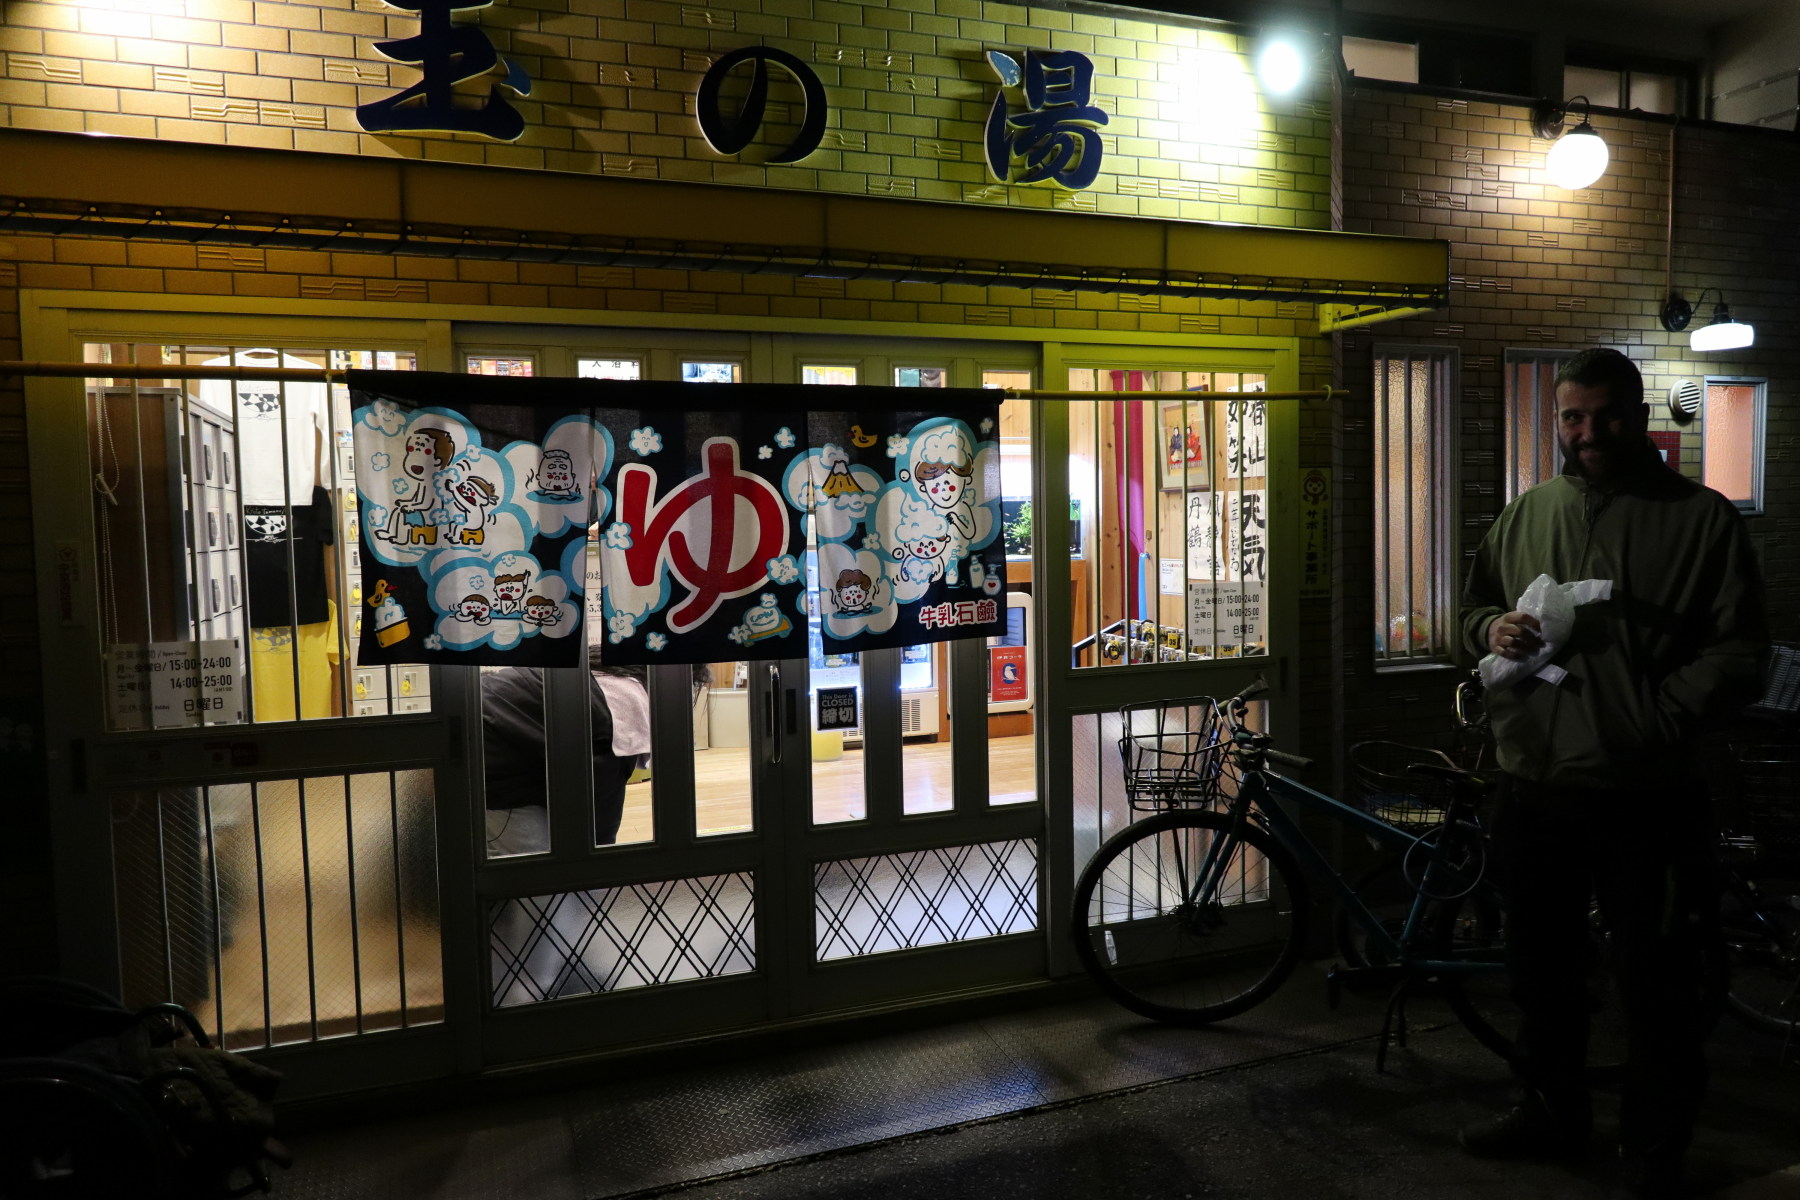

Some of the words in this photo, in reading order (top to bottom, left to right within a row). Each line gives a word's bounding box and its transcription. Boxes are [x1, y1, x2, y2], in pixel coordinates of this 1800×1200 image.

[618, 438, 788, 631] ゆ
[1168, 638, 1177, 646] 35
[821, 698, 854, 708] CLOSED
